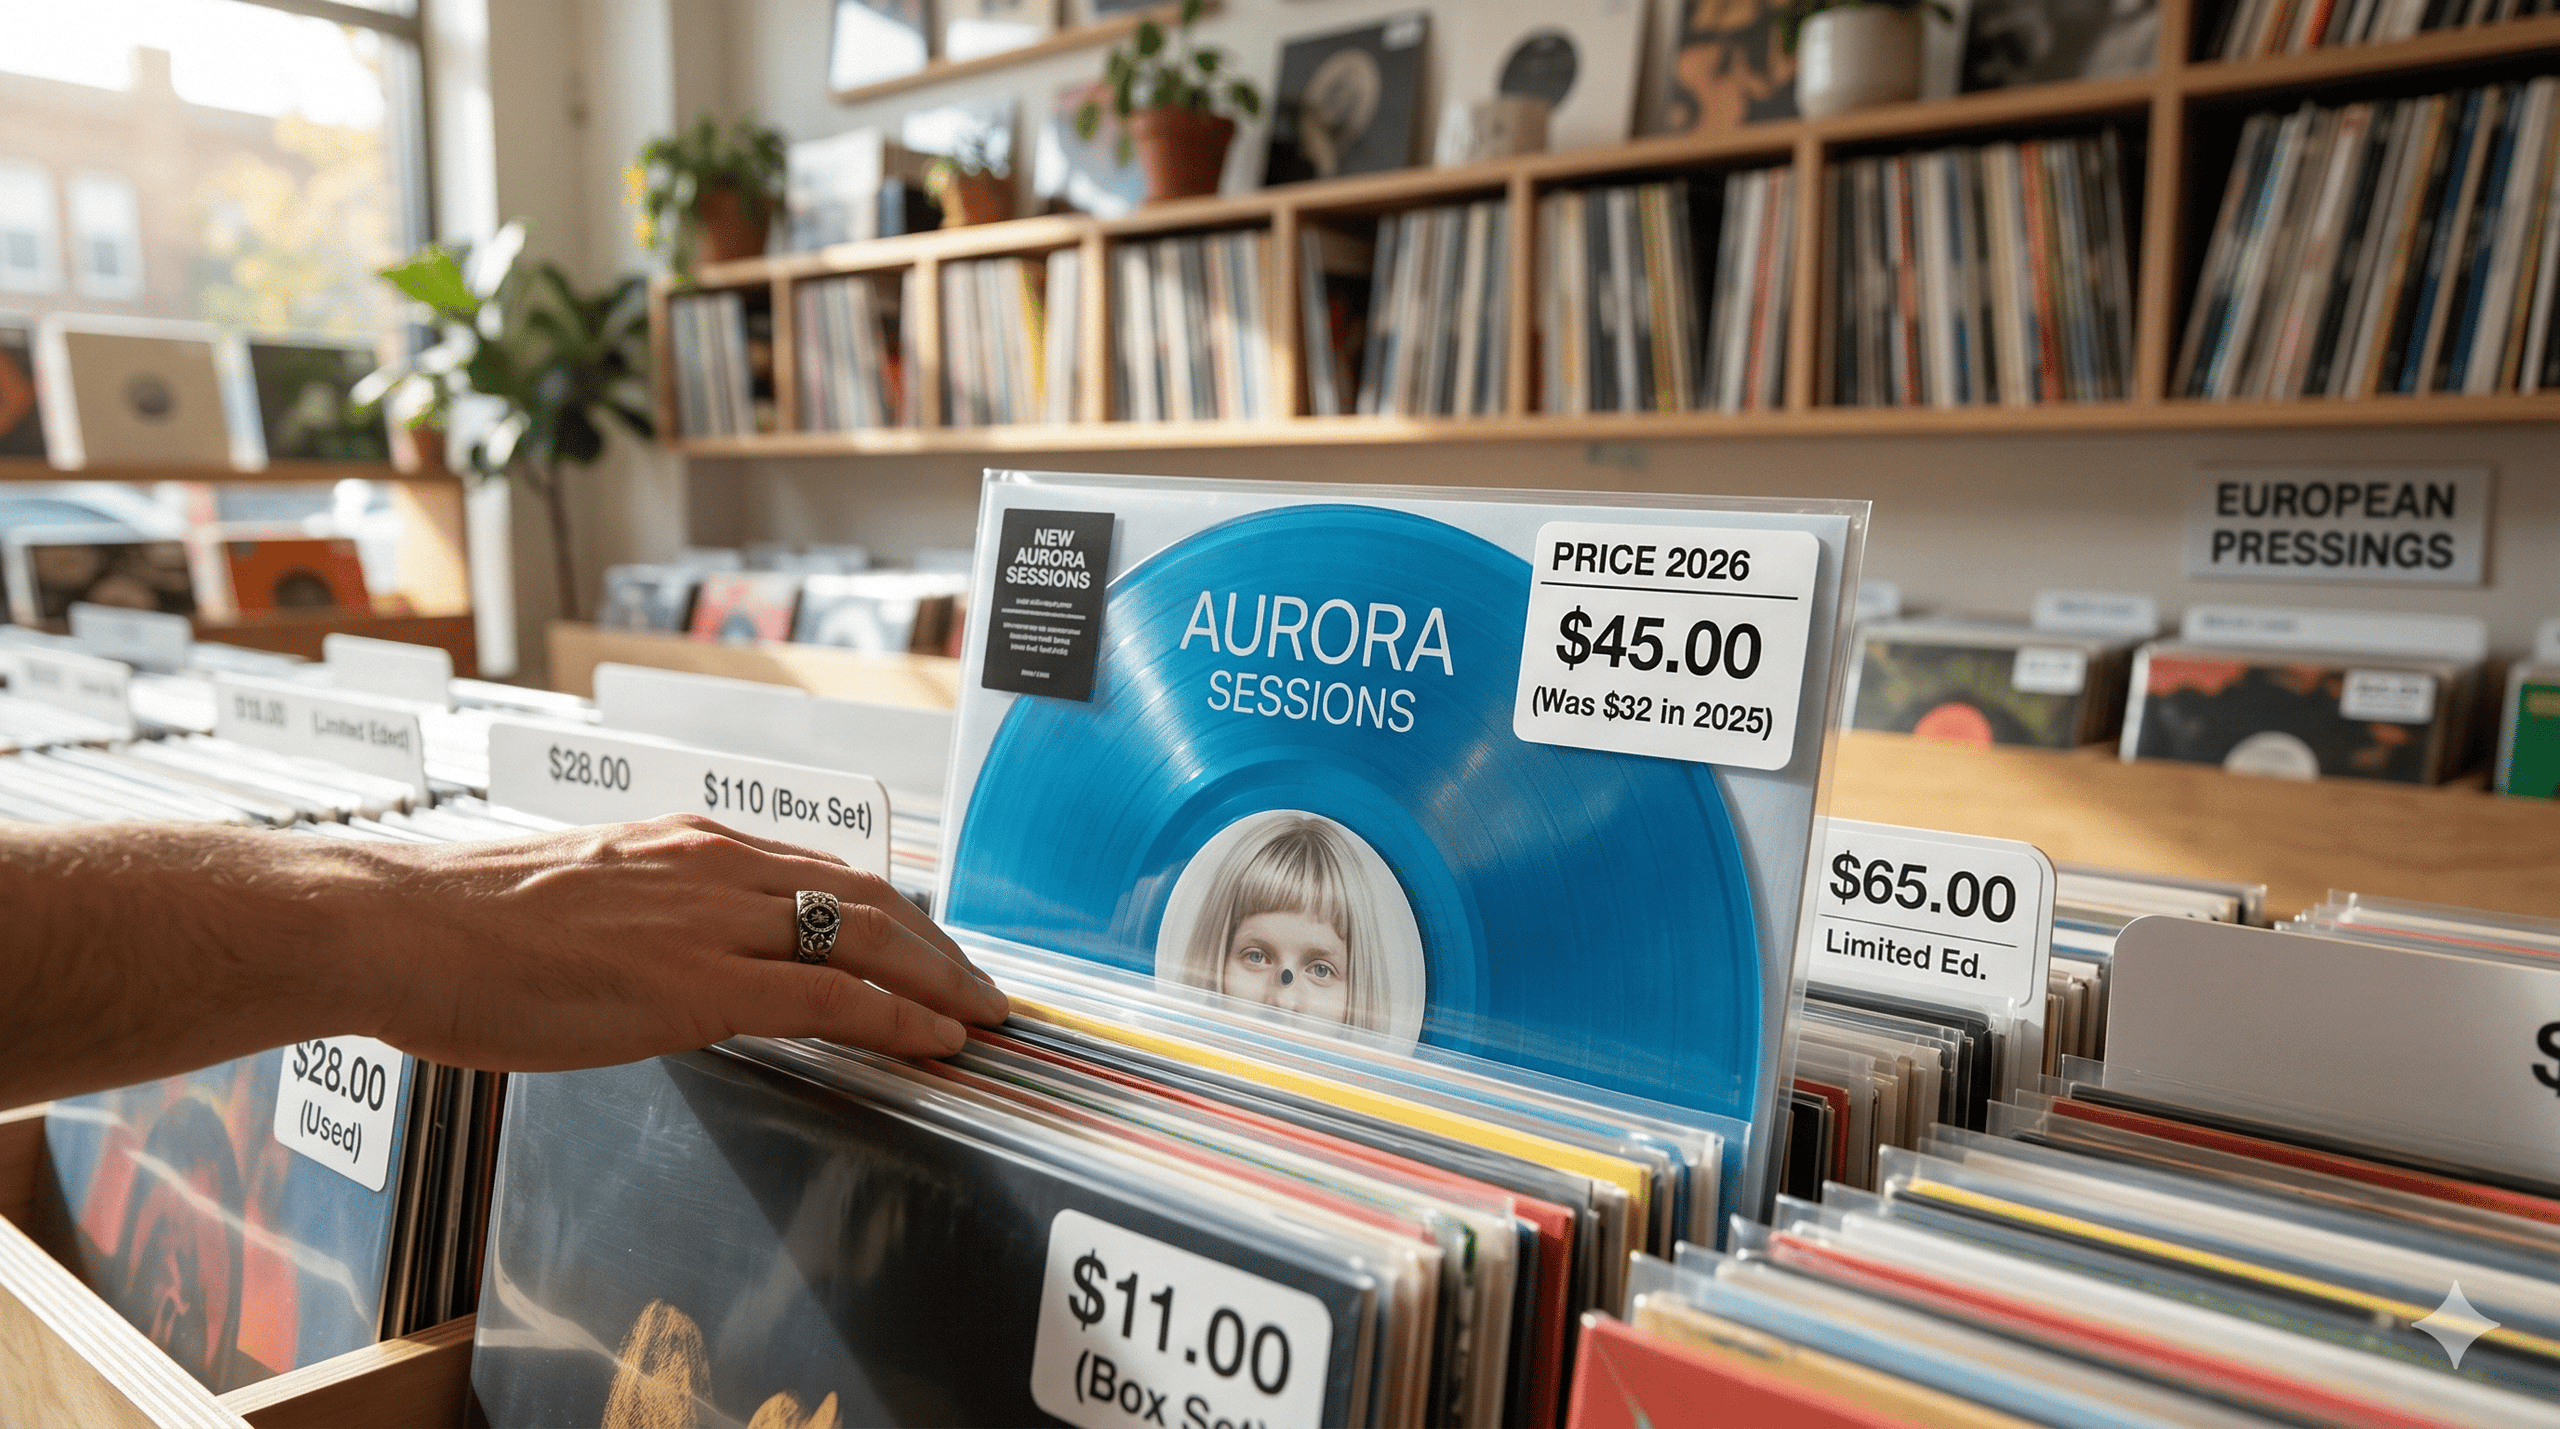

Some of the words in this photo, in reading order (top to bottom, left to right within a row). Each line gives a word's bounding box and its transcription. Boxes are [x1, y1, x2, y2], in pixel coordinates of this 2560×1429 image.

[2216, 481, 2457, 520] EUROPEAN
[1014, 546, 1086, 569] AURORA
[1034, 528, 1075, 547] NEW
[1552, 541, 1656, 576] PRICE
[1665, 546, 1751, 581] 2026
[2211, 529, 2455, 570] PRESSINGS
[1005, 565, 1091, 590] SESSIONS
[1179, 590, 1454, 676] AURORA
[1556, 604, 1762, 680] $45.00
[1207, 669, 1416, 733] SESSIONS
[1532, 685, 1596, 718] (Was
[1603, 690, 1651, 722] $32
[1660, 698, 1686, 726] in
[1693, 701, 1773, 741] 2025)
[548, 746, 631, 792] $28.00
[705, 769, 764, 815] $110
[772, 787, 820, 822] (Box
[827, 796, 873, 840] Set)
[1829, 849, 2017, 923] $65.00
[1825, 928, 1932, 970] Limited
[1940, 947, 1987, 981] Ed.
[293, 1038, 386, 1112] $28.00
[300, 1099, 362, 1165] (Used)
[1068, 1249, 1291, 1396] $11.00
[1075, 1350, 1168, 1427] (Box
